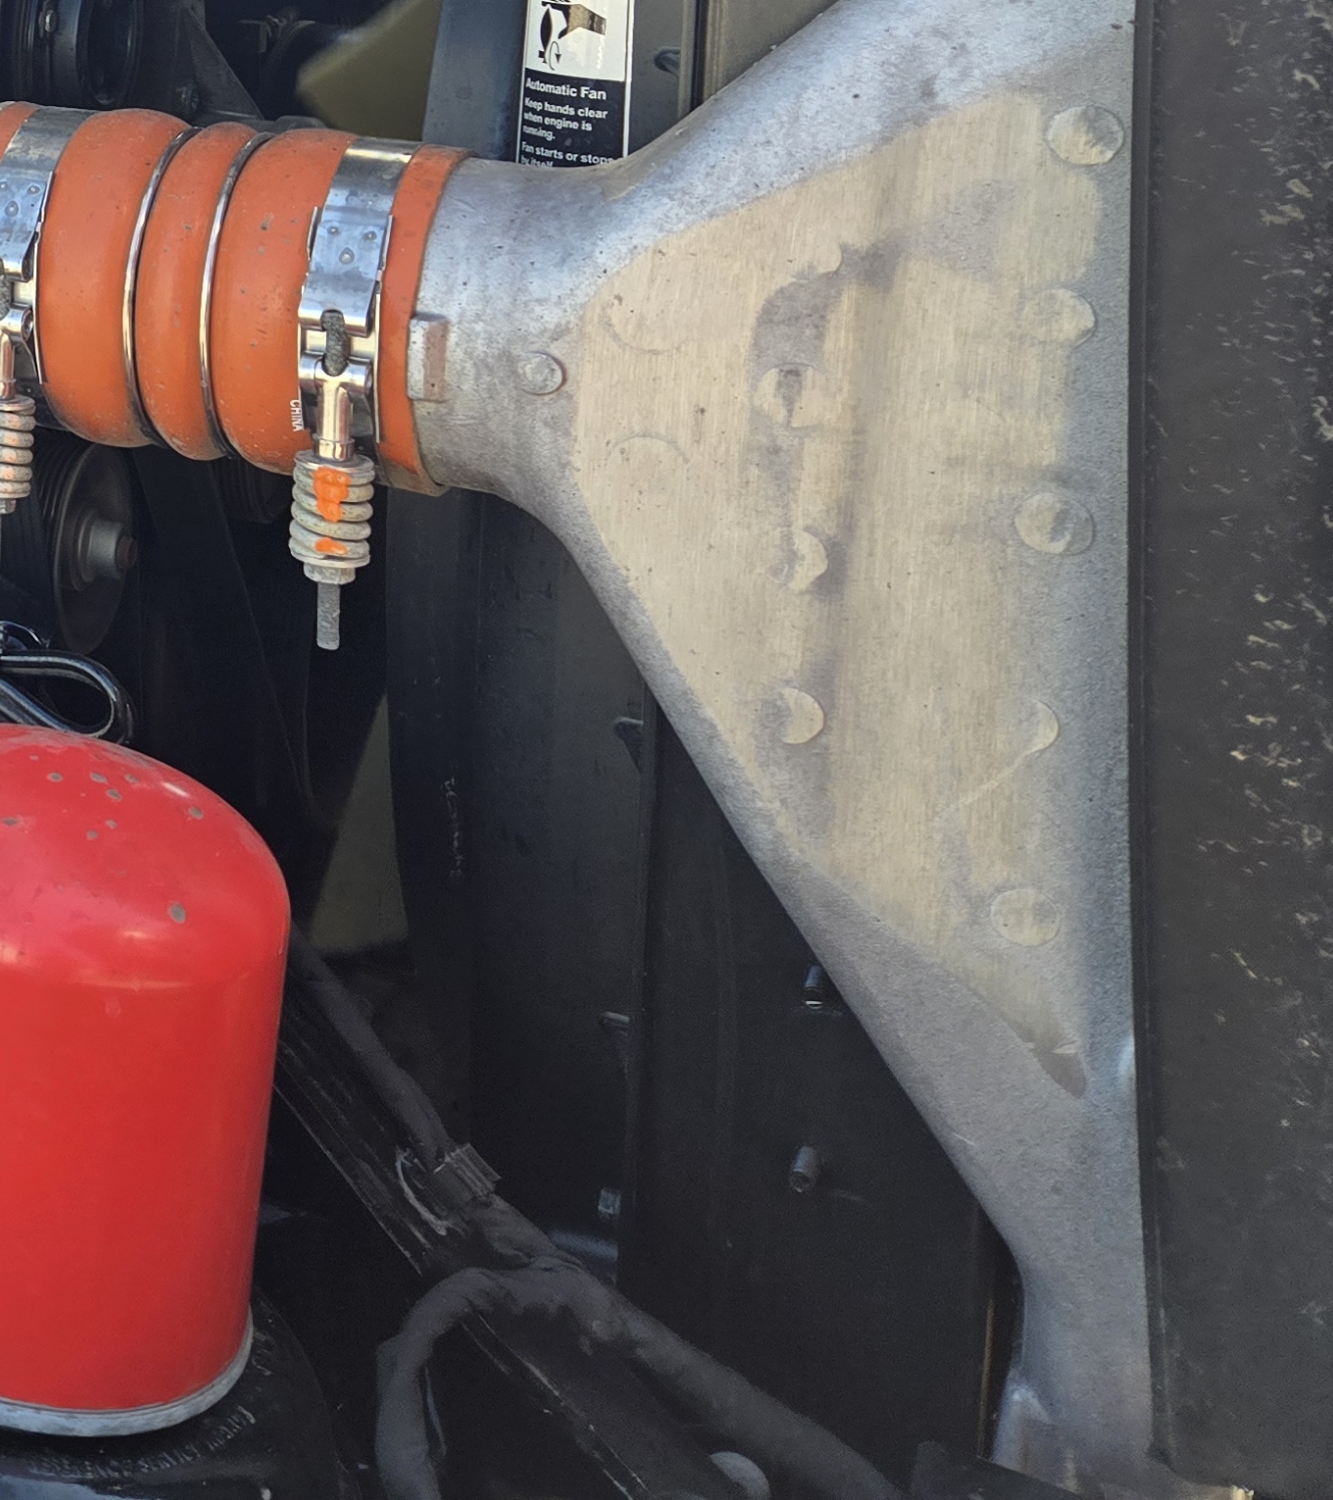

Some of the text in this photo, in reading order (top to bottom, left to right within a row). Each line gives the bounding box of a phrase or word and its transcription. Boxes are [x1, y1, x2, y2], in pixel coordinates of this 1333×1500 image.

[526, 77, 607, 100] Automatic Fan
[524, 97, 608, 119] Keep hands clear
[523, 111, 593, 131] when engine is
[521, 141, 534, 154] Fan
[535, 146, 564, 159] starts
[565, 152, 579, 161] or
[289, 399, 304, 432] CHINA
